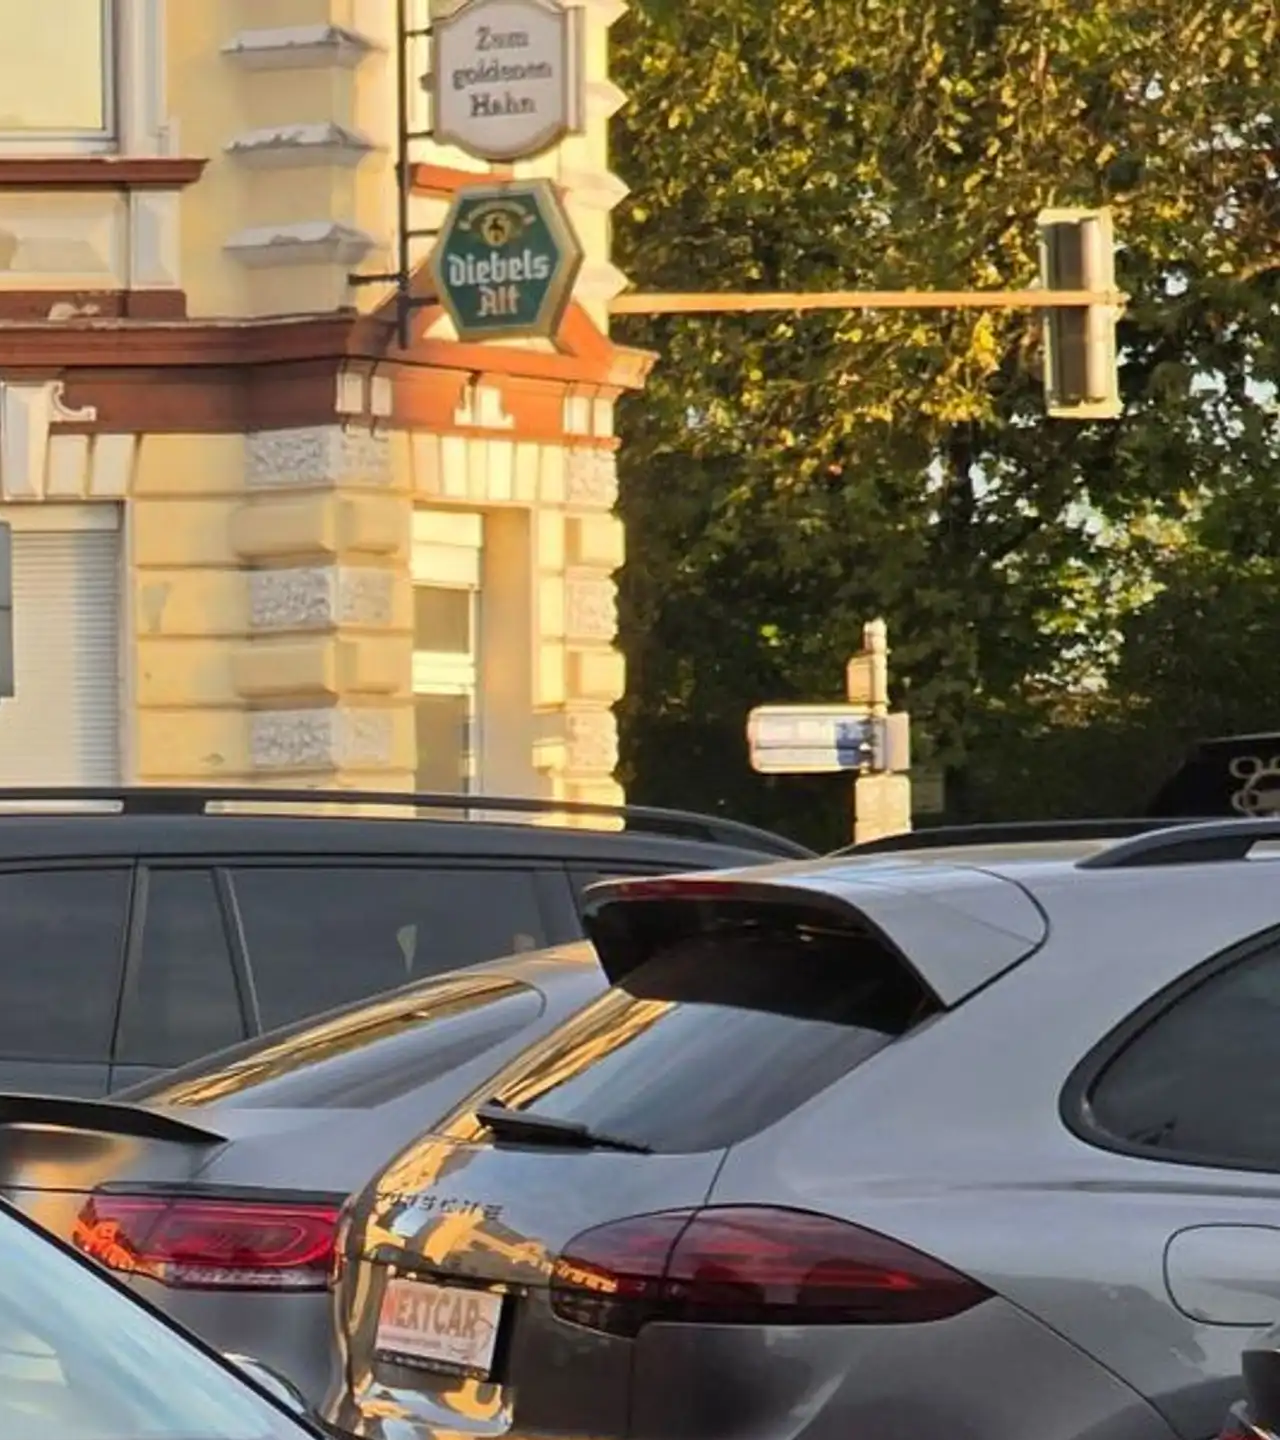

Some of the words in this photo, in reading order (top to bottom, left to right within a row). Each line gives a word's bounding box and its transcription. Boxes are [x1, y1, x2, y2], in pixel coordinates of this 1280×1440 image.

[475, 25, 529, 51] Zum
[452, 58, 553, 90] goldenen
[469, 91, 538, 118] Hahn
[446, 248, 550, 287] Diebels
[477, 284, 520, 317] Alt
[382, 1286, 482, 1338] NEXTCAR
